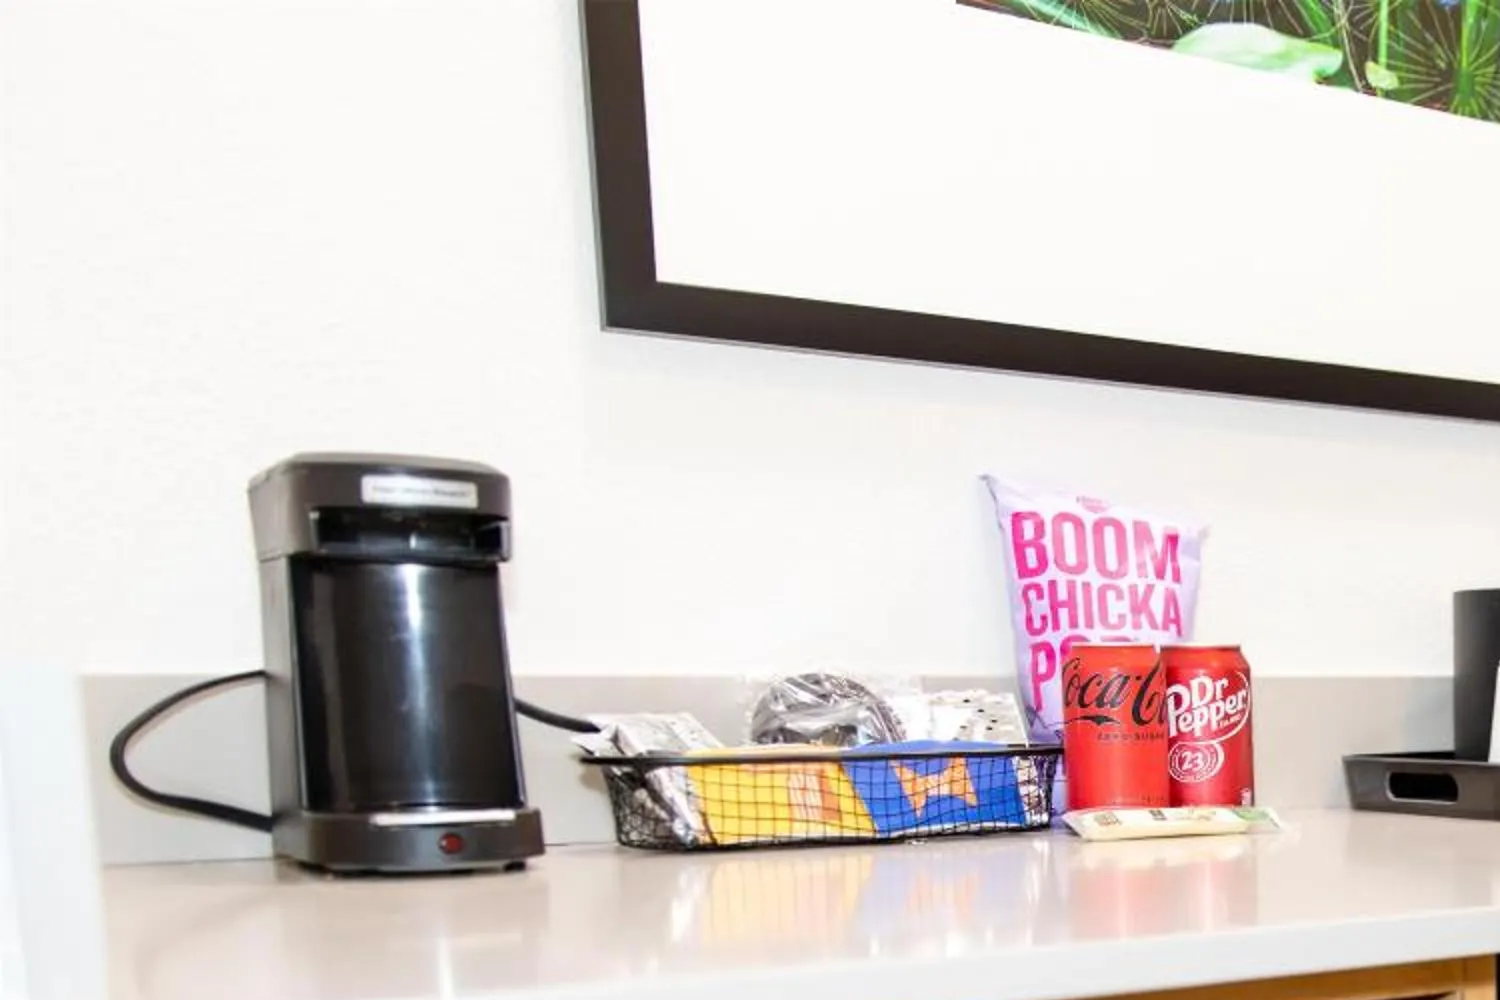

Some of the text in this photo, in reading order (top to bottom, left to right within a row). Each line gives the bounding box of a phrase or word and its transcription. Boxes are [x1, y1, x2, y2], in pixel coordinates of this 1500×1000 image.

[1011, 511, 1182, 584] BOOM
[1022, 579, 1183, 637] CHICKA
[1061, 656, 1167, 726] Coca-C
[1166, 683, 1247, 737] Pepper
[1189, 675, 1229, 709] Dr
[1181, 750, 1205, 772] 23
